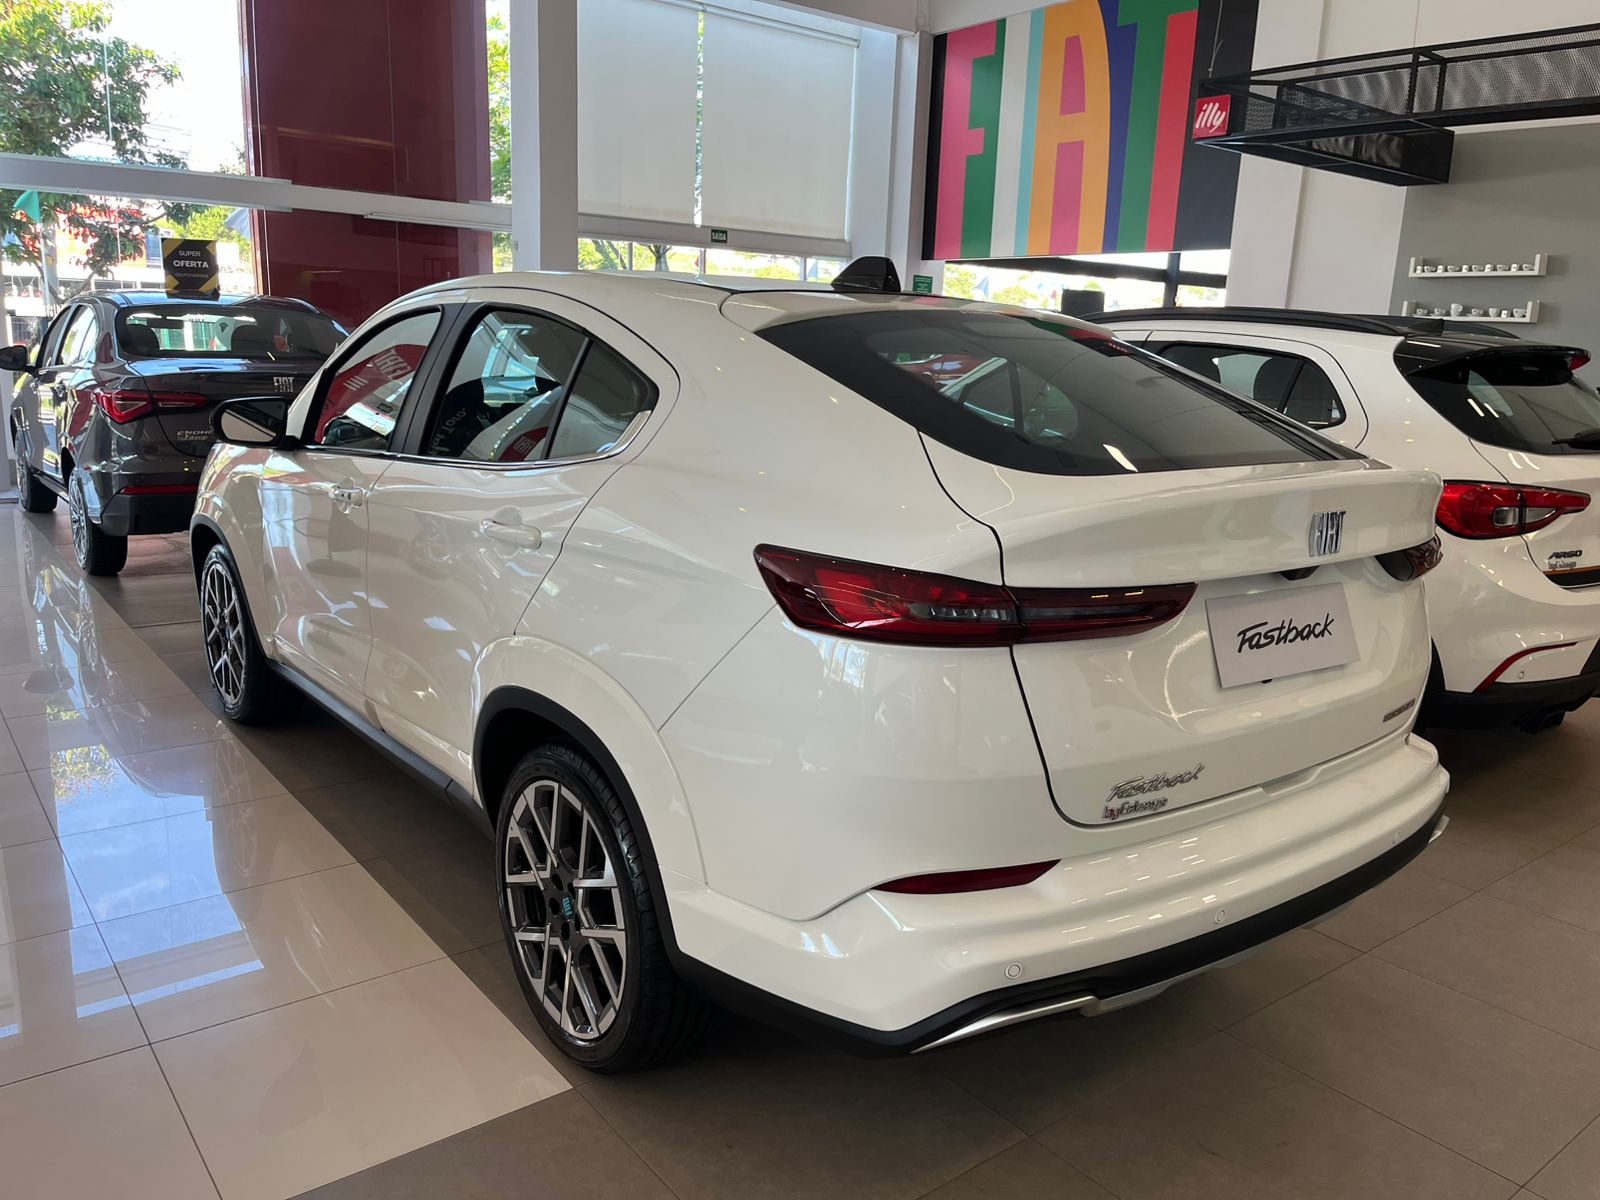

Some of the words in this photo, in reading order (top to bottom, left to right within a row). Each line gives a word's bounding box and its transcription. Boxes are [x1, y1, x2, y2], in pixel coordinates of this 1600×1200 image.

[934, 0, 1199, 259] FIAT
[1195, 102, 1226, 133] illy
[173, 260, 209, 268] OFERTA
[273, 376, 295, 393] FIAT
[1309, 511, 1346, 557] FIAT
[1548, 550, 1582, 560] ARGO
[1237, 612, 1334, 653] Fastback
[1106, 762, 1205, 802] Fastback
